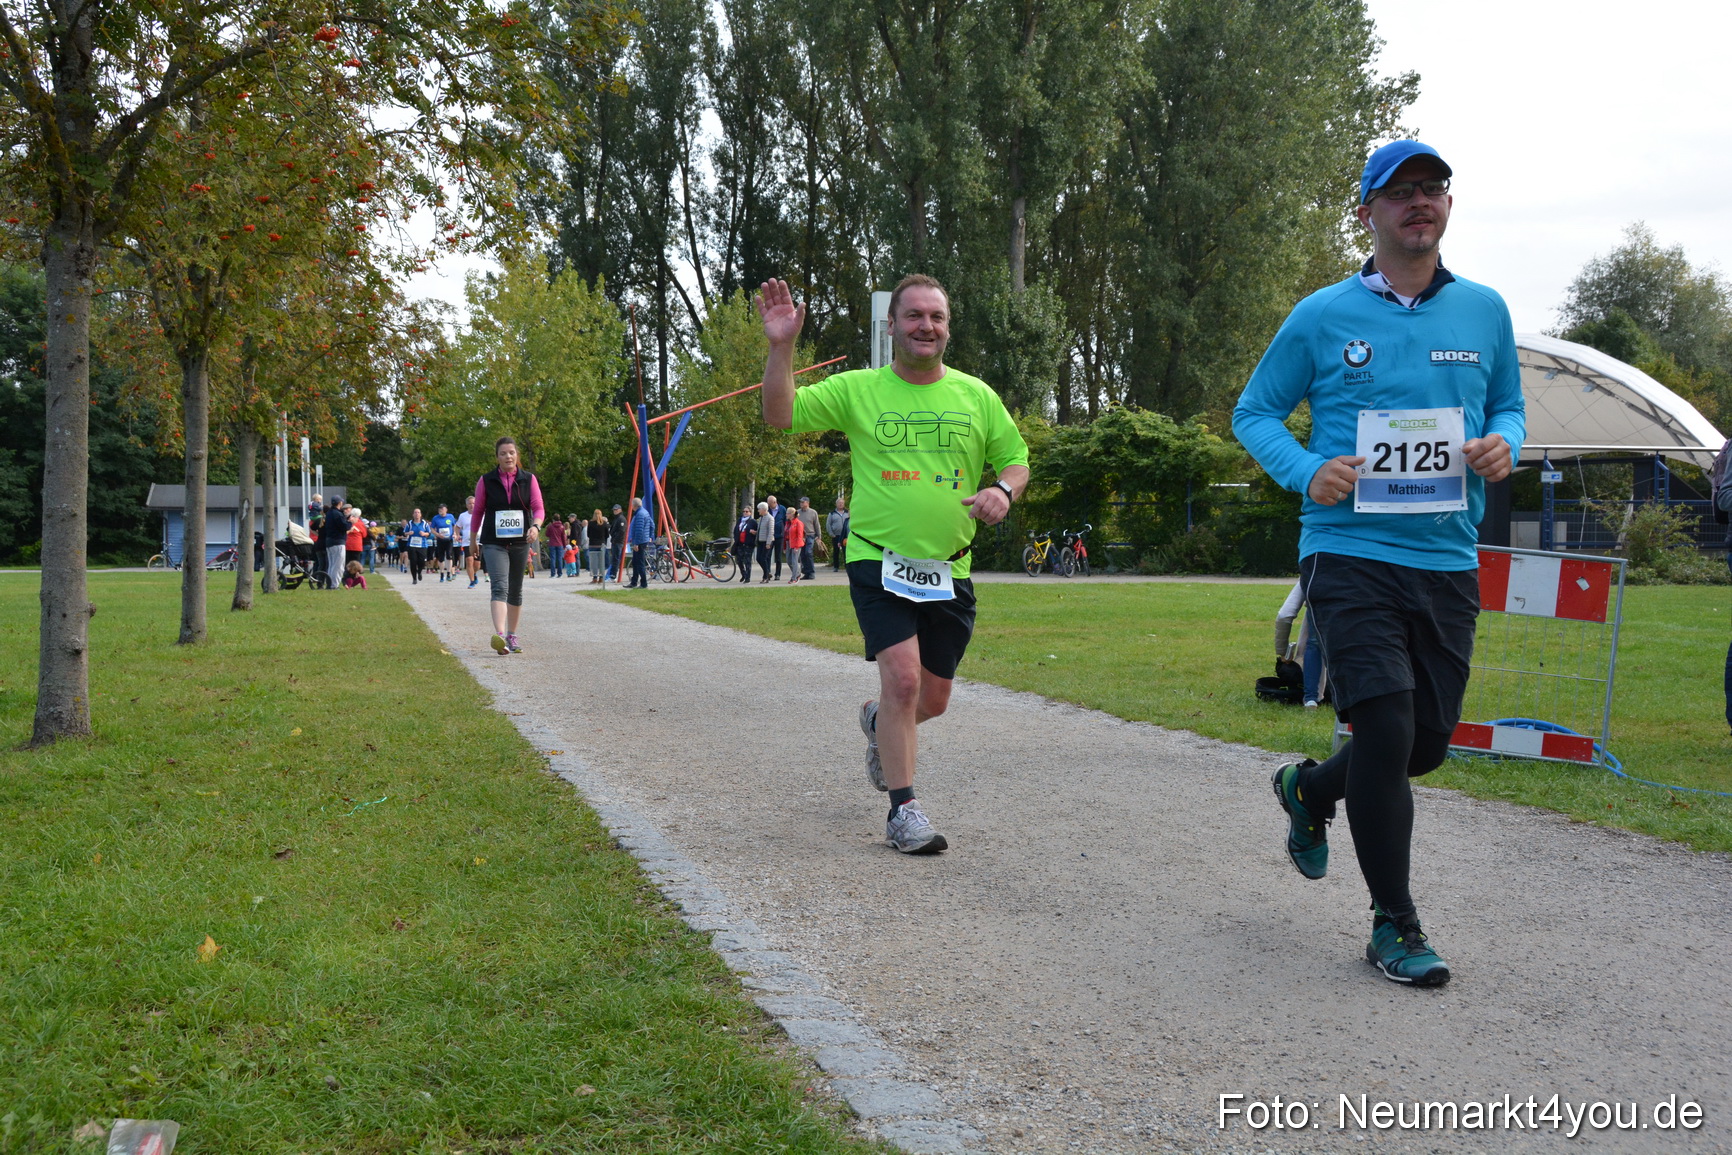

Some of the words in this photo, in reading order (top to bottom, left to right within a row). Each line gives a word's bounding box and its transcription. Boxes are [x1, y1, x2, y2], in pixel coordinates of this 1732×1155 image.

[1430, 350, 1480, 364] BOCK
[1344, 371, 1374, 380] PARTL
[1345, 378, 1374, 386] Neumarkt
[875, 411, 971, 447] OPF
[1400, 419, 1437, 428] BOCK
[1372, 441, 1450, 473] 2125
[881, 470, 920, 481] MERZ
[1388, 483, 1436, 495] Matthias
[500, 518, 520, 528] 2606
[892, 562, 941, 587] 2090
[907, 587, 926, 597] Sepp
